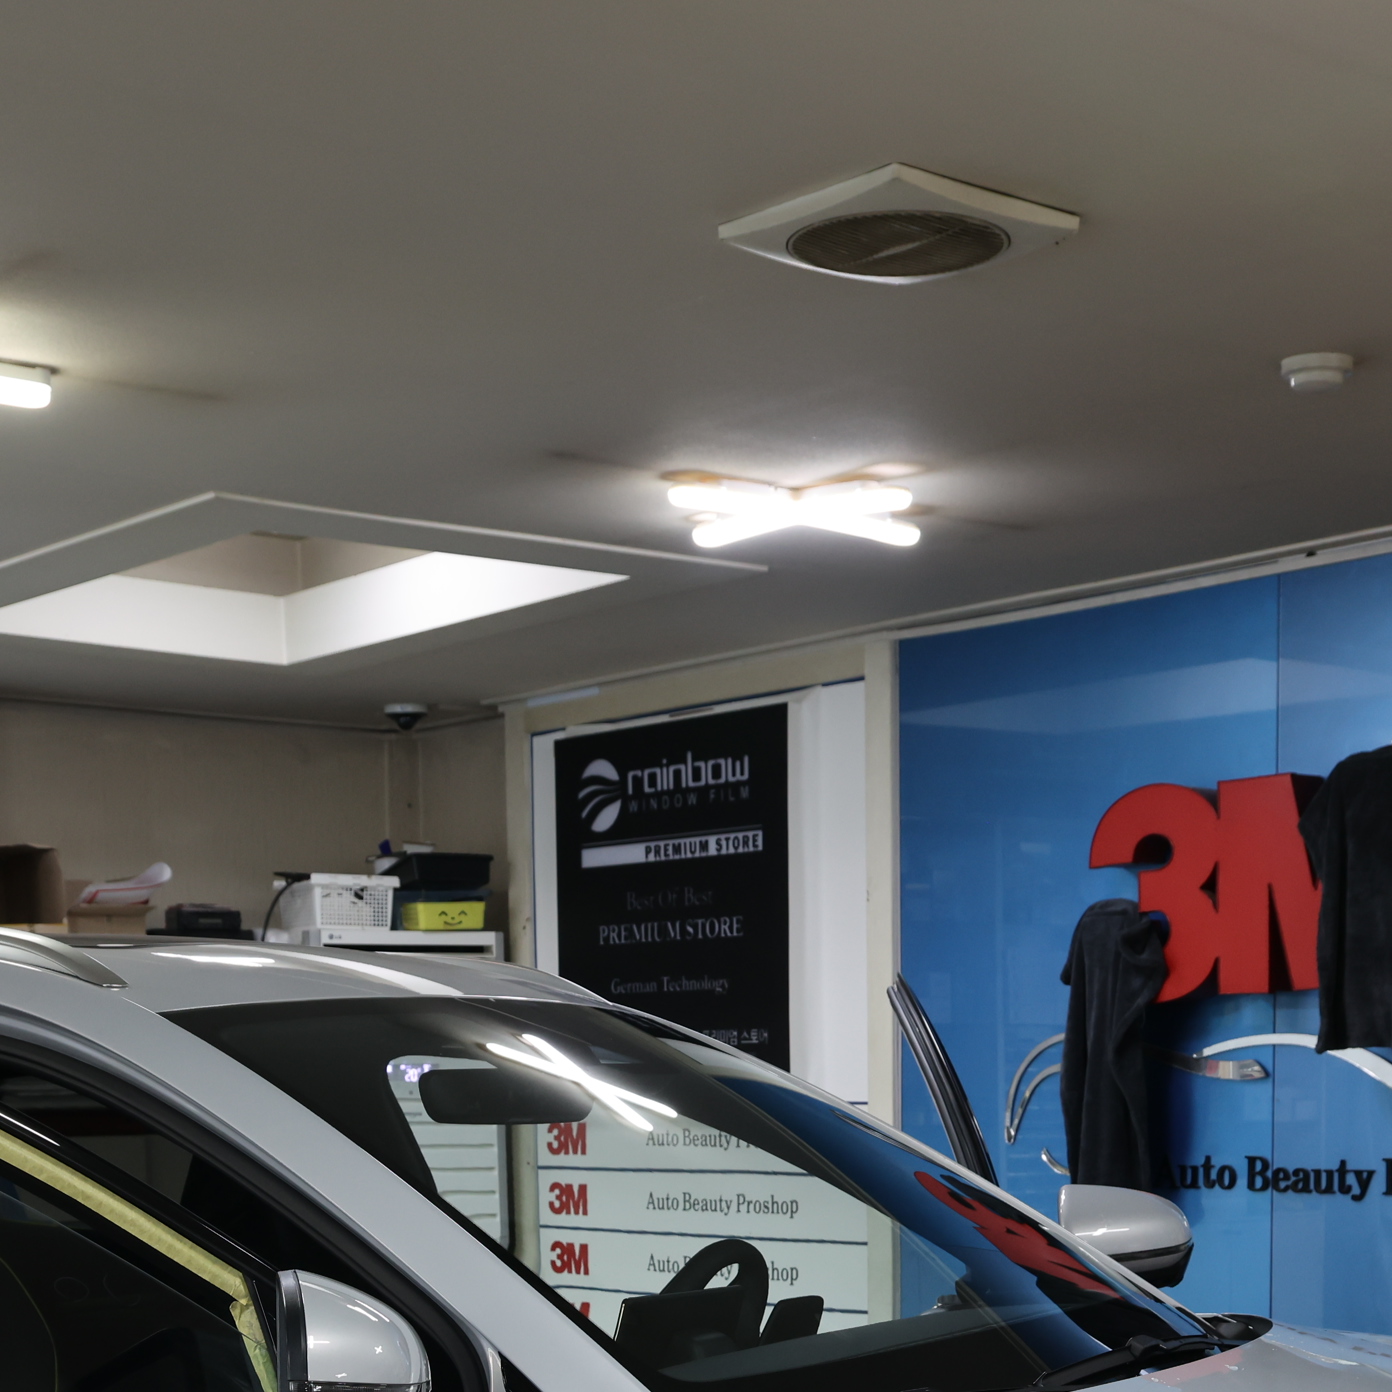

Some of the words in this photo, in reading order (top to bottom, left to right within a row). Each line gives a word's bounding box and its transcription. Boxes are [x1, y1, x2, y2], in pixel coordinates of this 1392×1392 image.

[627, 751, 749, 795] rainbow
[628, 791, 697, 813] WINDOW
[709, 785, 750, 804] FILM
[645, 838, 709, 860] PREMIUM
[715, 833, 760, 852] STORE
[599, 919, 681, 945] PREMIUM
[686, 915, 743, 940] STORE
[610, 977, 657, 994] German
[662, 974, 729, 995] Technology
[547, 1122, 587, 1156] 3M
[646, 1129, 679, 1147] Auto
[683, 1128, 733, 1150] Beauty
[1245, 1156, 1376, 1201] Beauty
[548, 1182, 588, 1216] 3M
[646, 1191, 679, 1211] Auto
[682, 1192, 732, 1215] Beauty
[736, 1194, 799, 1219] Proshop
[550, 1241, 589, 1276] 3M
[647, 1253, 680, 1273] Auto
